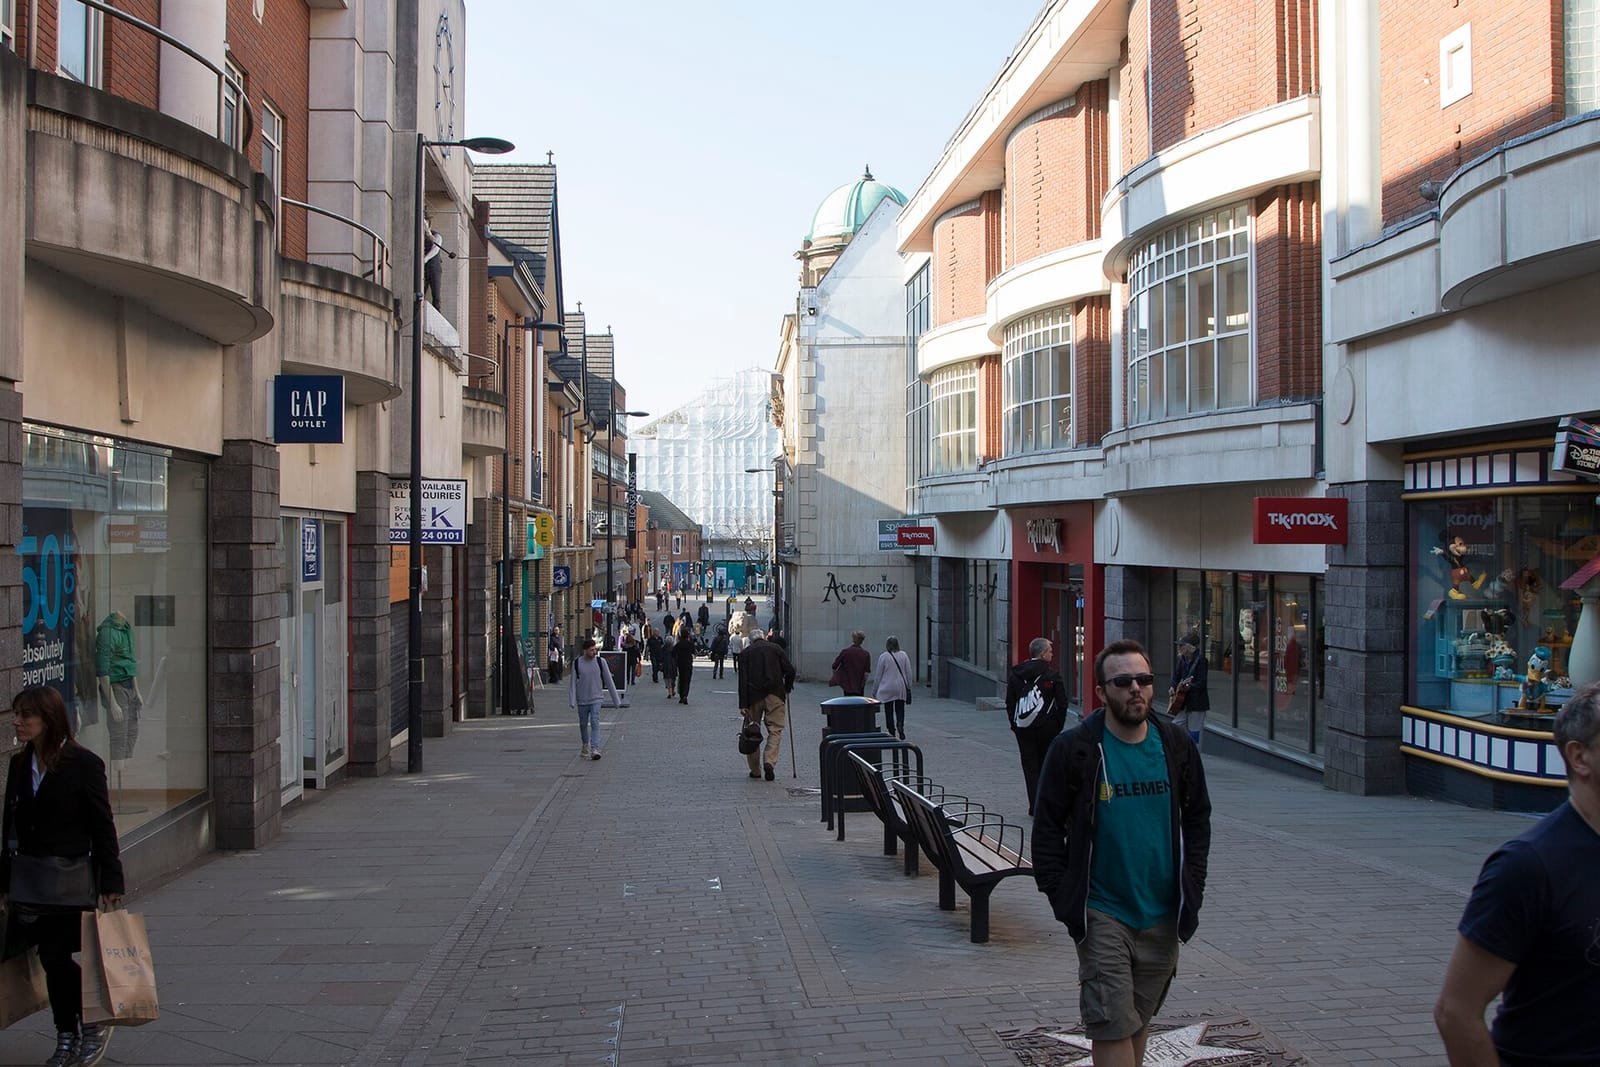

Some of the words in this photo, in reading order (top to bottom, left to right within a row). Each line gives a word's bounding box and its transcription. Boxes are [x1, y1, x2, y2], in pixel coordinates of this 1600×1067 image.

[291, 390, 327, 417] GAP
[291, 420, 327, 428] OUTLET
[421, 483, 462, 491] VAILABLE
[422, 491, 462, 500] QUIRIES
[436, 531, 460, 540] 0101
[821, 571, 899, 605] Accessorize
[22, 639, 65, 664] absolutely
[23, 661, 65, 687] everything
[1114, 780, 1172, 798] ELEMEN
[105, 945, 138, 958] PRIM
